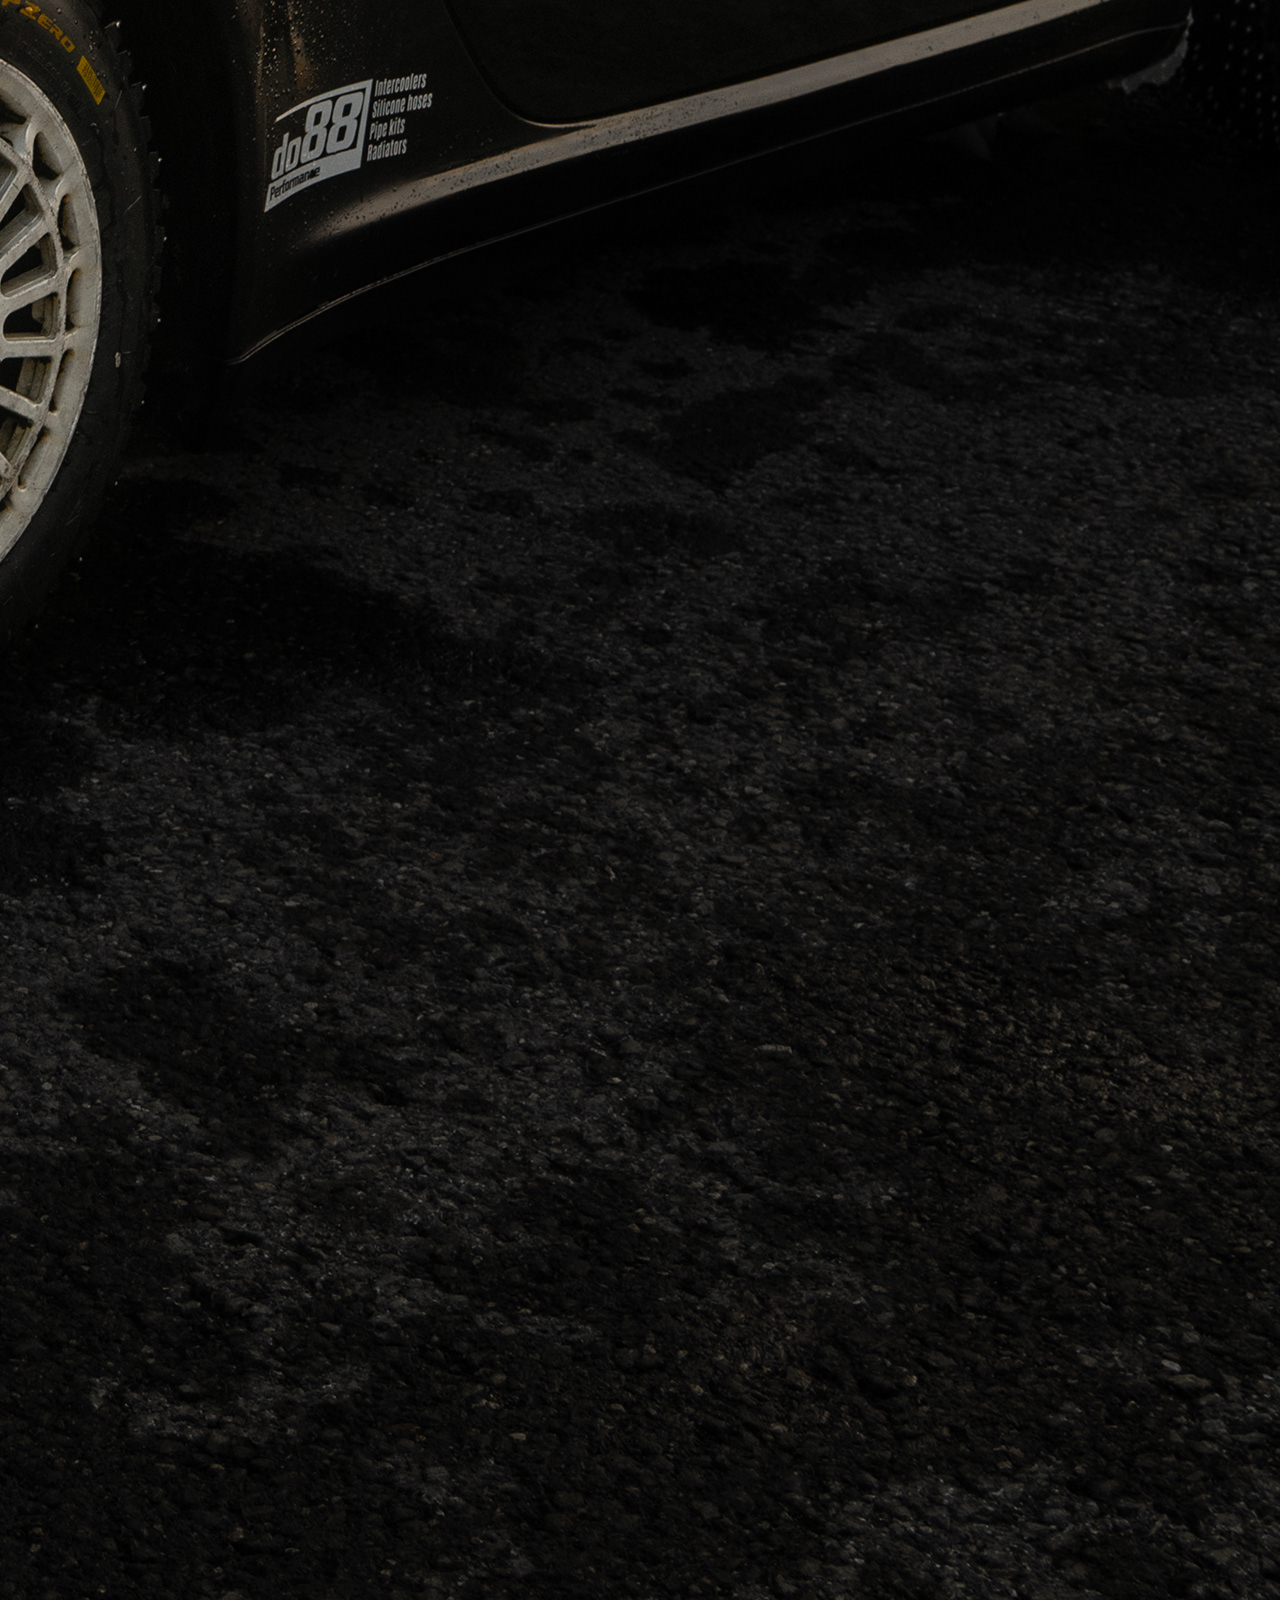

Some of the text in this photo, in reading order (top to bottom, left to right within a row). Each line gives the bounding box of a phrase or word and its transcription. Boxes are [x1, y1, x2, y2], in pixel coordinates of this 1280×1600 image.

[20, 0, 75, 53] ZERO
[372, 92, 433, 119] Silicone hoses
[271, 72, 428, 181] do88 Intercoolers
[369, 117, 406, 141] Pipe kits
[366, 138, 408, 162] Radiators
